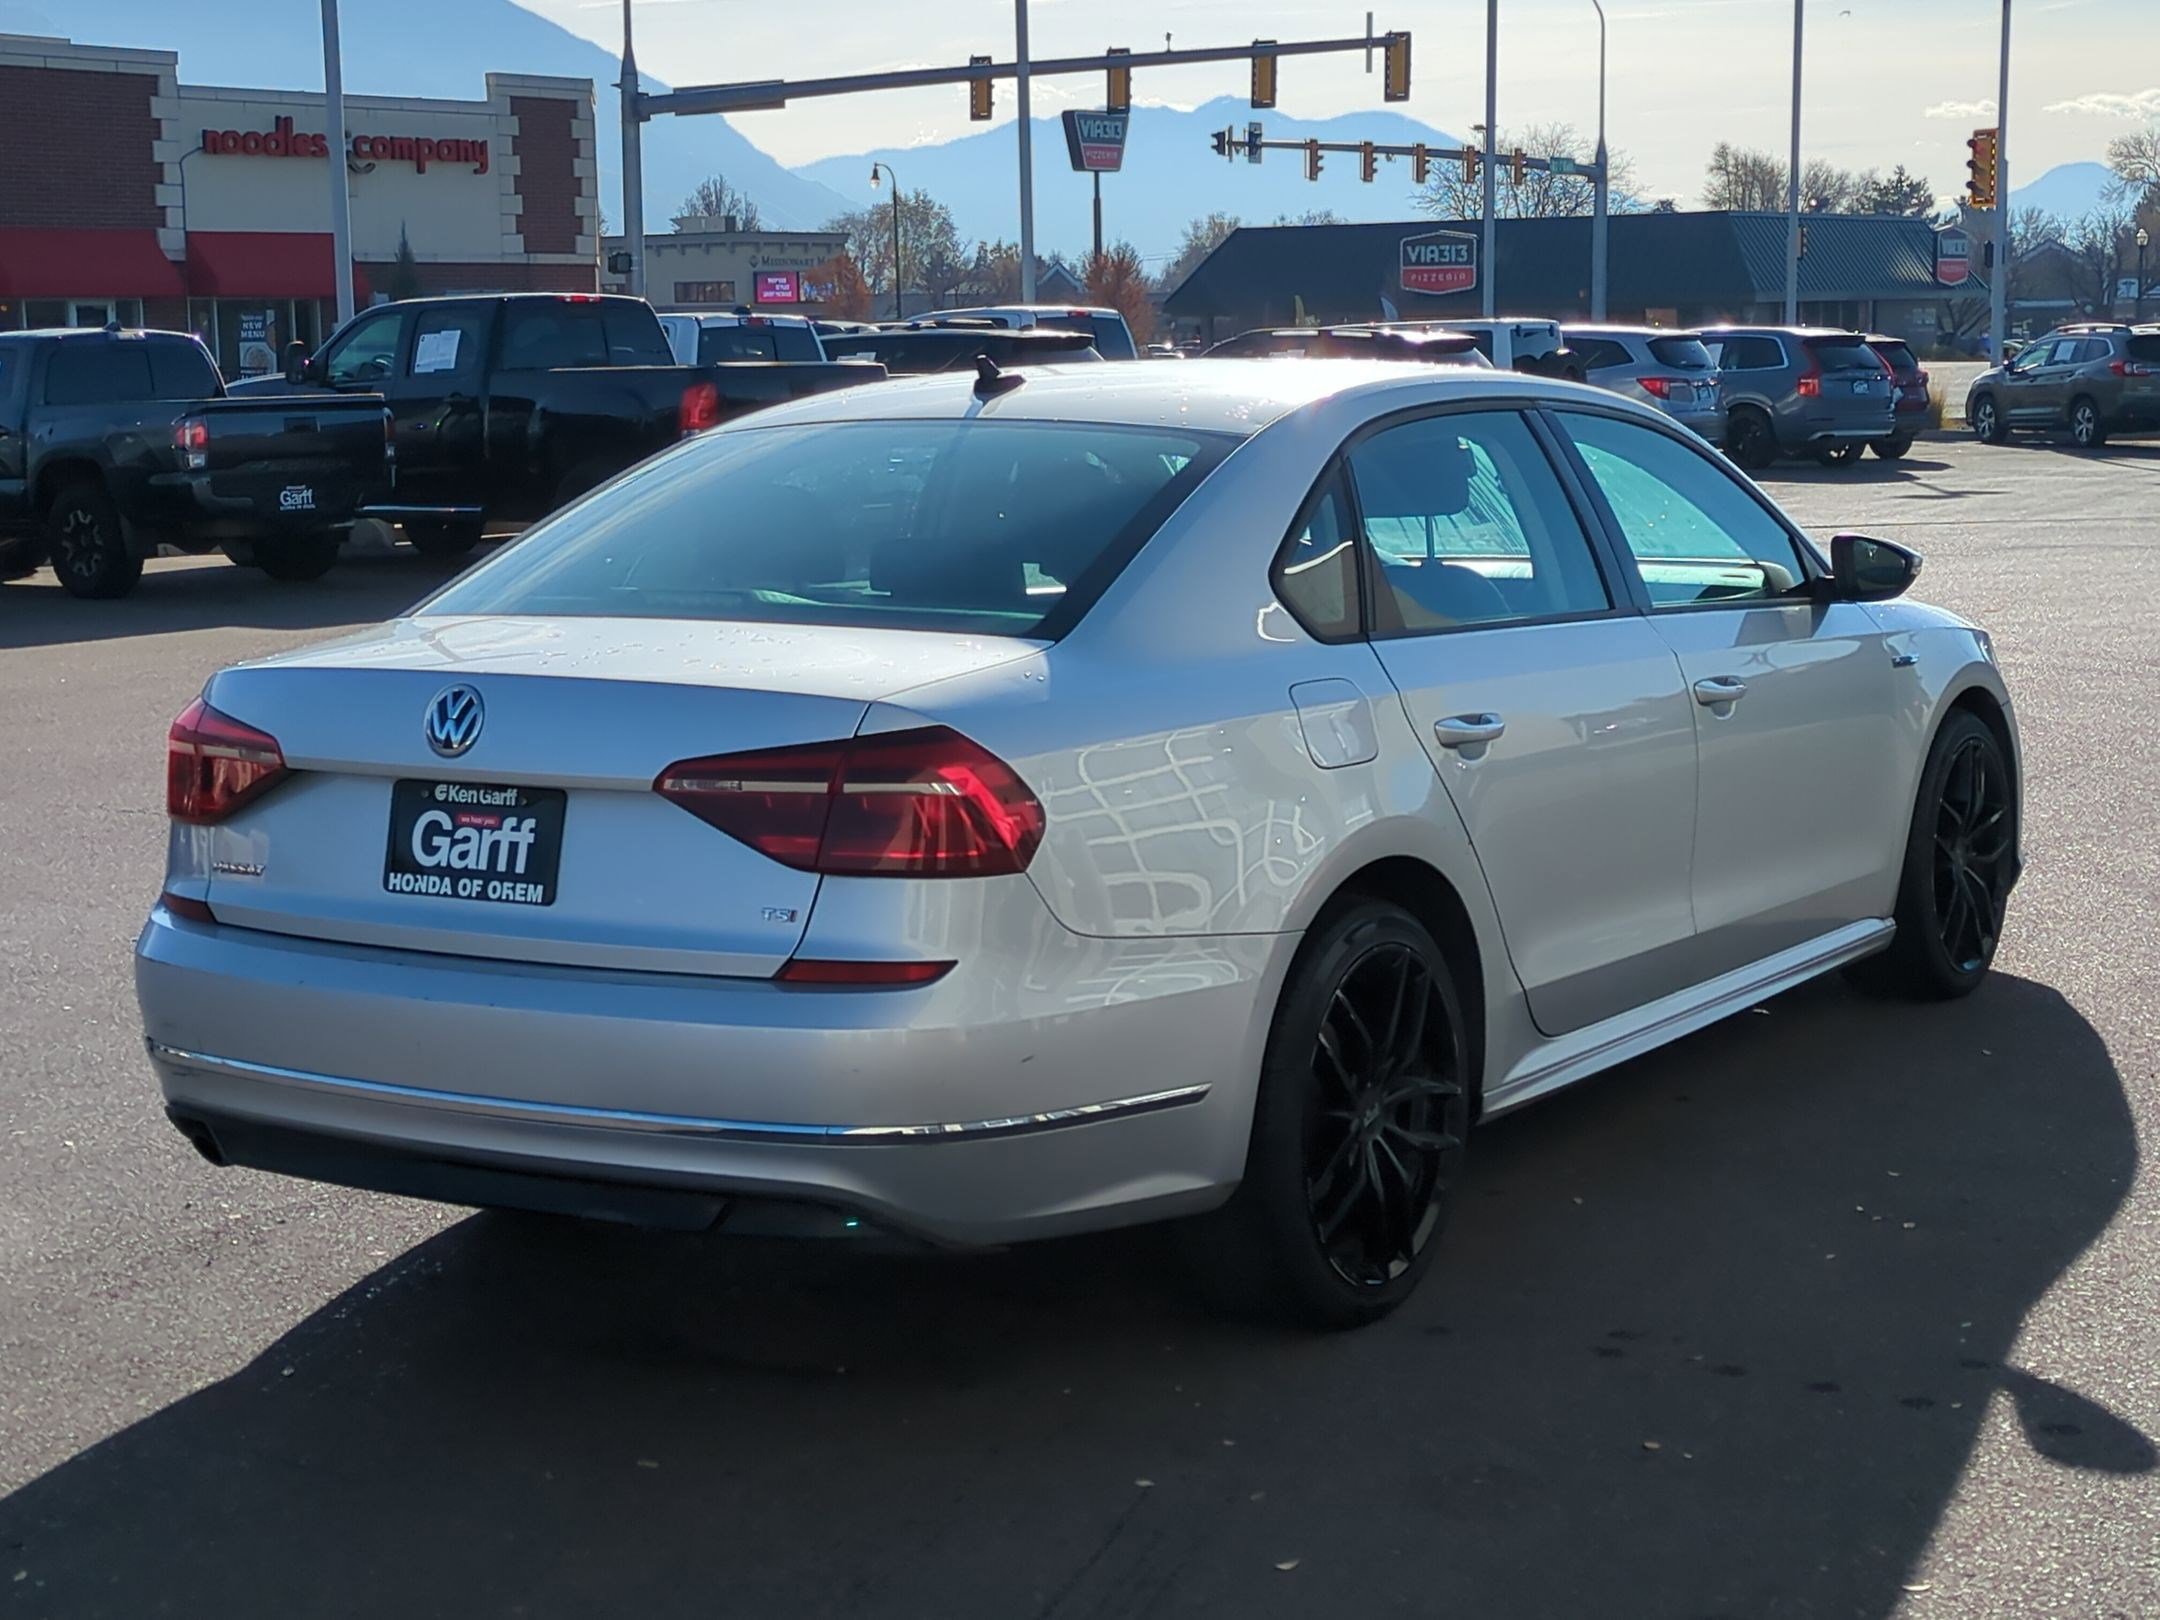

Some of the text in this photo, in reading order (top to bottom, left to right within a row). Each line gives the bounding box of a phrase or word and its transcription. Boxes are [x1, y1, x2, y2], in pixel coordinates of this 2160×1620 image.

[202, 115, 330, 158] noodles
[352, 135, 488, 174] company
[1411, 272, 1466, 282] PIZZERIA
[240, 330, 265, 338] MENU
[242, 321, 263, 330] NEW
[280, 488, 313, 506] Garff
[448, 785, 477, 804] Ken
[479, 788, 518, 806] Garff
[412, 809, 537, 874] Garff
[388, 872, 544, 904] HONDA OF OREM
